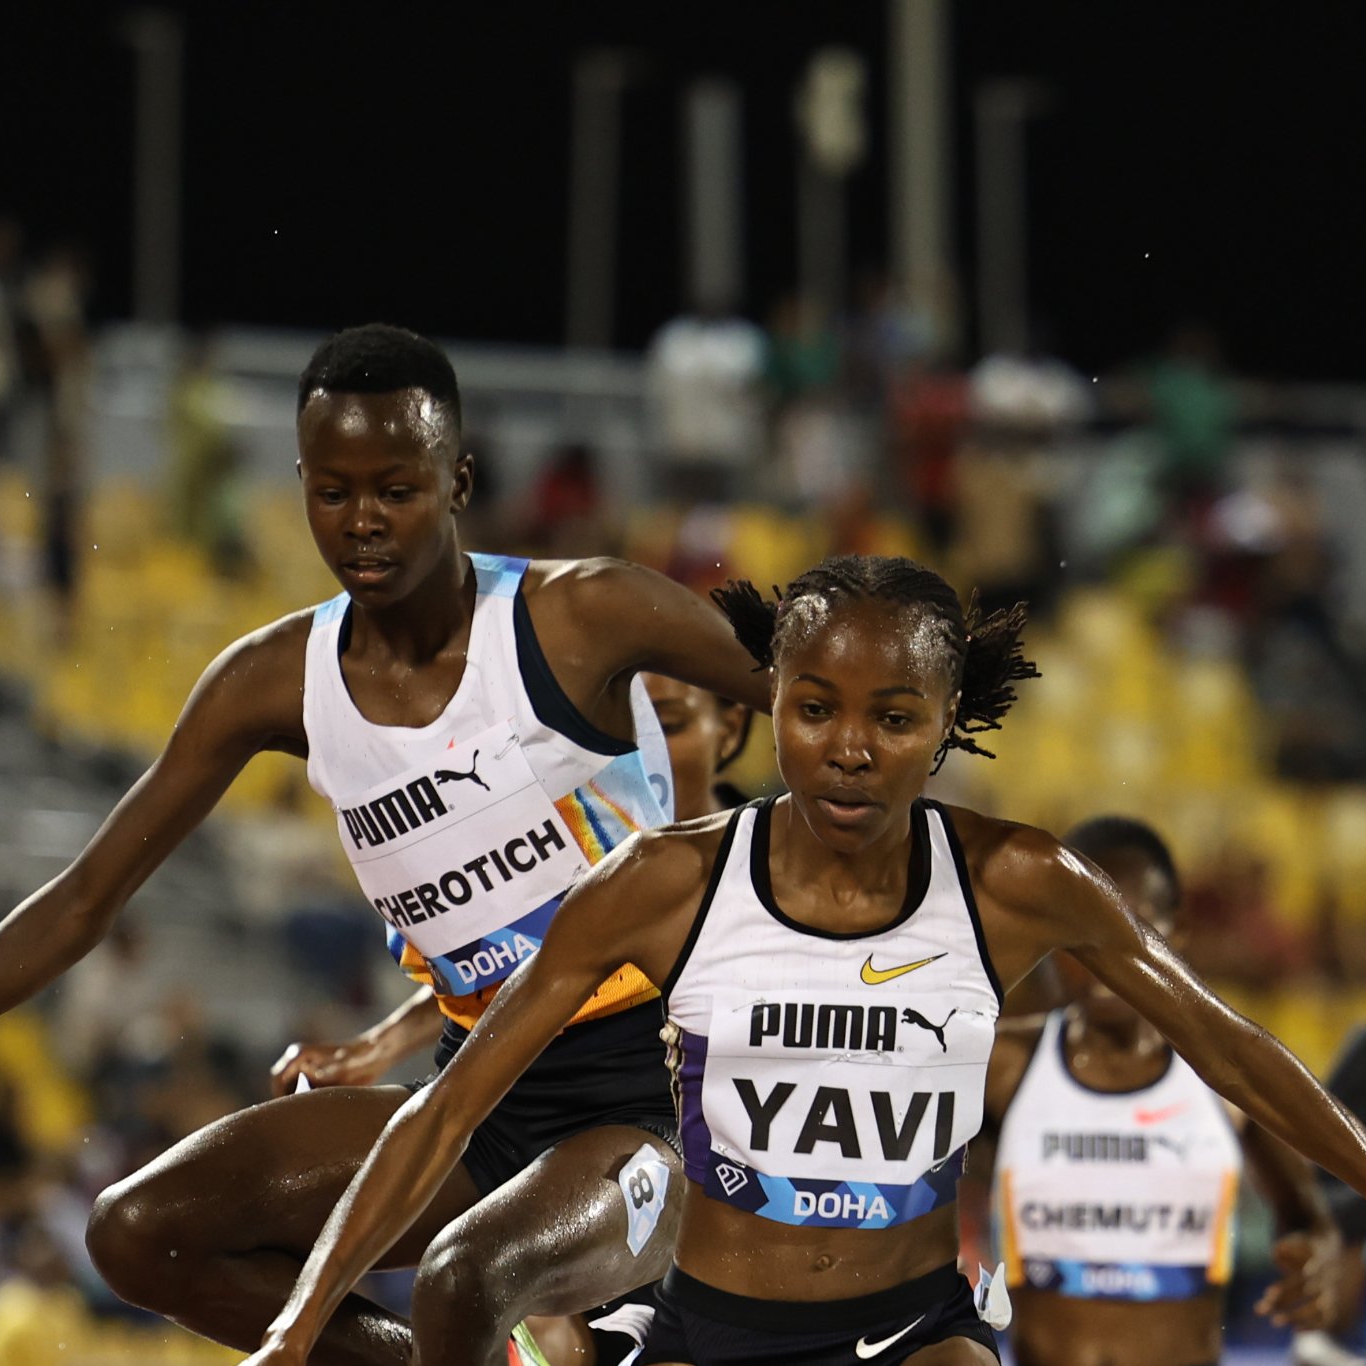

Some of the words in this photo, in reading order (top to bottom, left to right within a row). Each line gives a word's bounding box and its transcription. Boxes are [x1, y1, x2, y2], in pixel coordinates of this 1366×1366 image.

[342, 776, 448, 850] PUMA
[374, 819, 566, 929] CHEROTICH
[454, 933, 538, 984] DOHA
[749, 1003, 898, 1052] PUMA
[732, 1077, 956, 1162] YAVI
[1042, 1132, 1149, 1162] PUMA
[629, 1168, 655, 1210] 8
[793, 1191, 889, 1220] DOHA
[1020, 1201, 1208, 1233] CHEMUTAI
